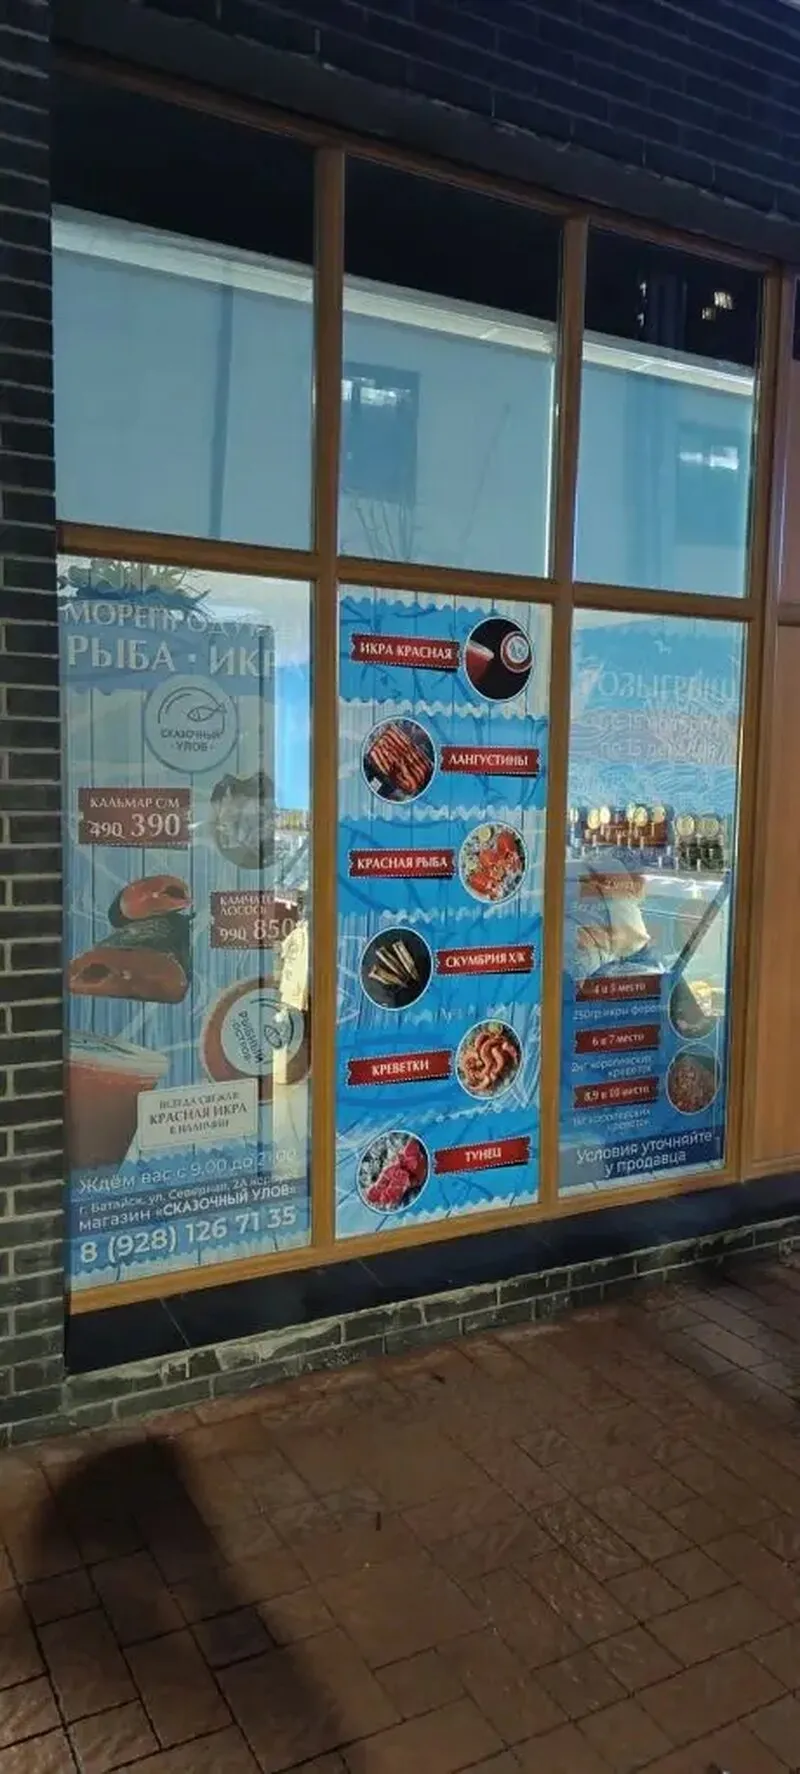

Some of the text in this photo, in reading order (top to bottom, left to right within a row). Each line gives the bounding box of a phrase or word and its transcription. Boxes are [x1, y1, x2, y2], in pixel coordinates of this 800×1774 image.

[67, 635, 176, 672] РЫБА
[360, 641, 453, 660] ИКРА КРАСНАЯ
[176, 742, 208, 752] УЛОВ
[450, 754, 529, 767] ЛАНГУСТИНЫ
[89, 798, 180, 809] КАЛЬМАР С/М
[88, 813, 181, 838] 490 390
[357, 856, 448, 870] КРАСНАЯ РЫБА
[254, 918, 295, 940] 850
[446, 953, 508, 968] СКУМБРИЯ
[618, 982, 647, 993] место
[616, 1033, 645, 1043] место
[372, 1060, 430, 1077] КРЕВЕТКИ
[150, 1102, 248, 1125] КРАСНАЯ ИКРА
[465, 1148, 502, 1163] ТУНЕЦ
[576, 1131, 713, 1165] Условия уточняйте
[604, 1149, 688, 1178] у продавца
[79, 1173, 136, 1194] Ждём
[141, 1169, 172, 1185] вас
[176, 1167, 187, 1179] с
[230, 1157, 254, 1173] до
[79, 1183, 297, 1232] магазин «СКАЗОЧНЫЙ УЛОВ»
[80, 1205, 297, 1264] 8 (928) 126 71 35
